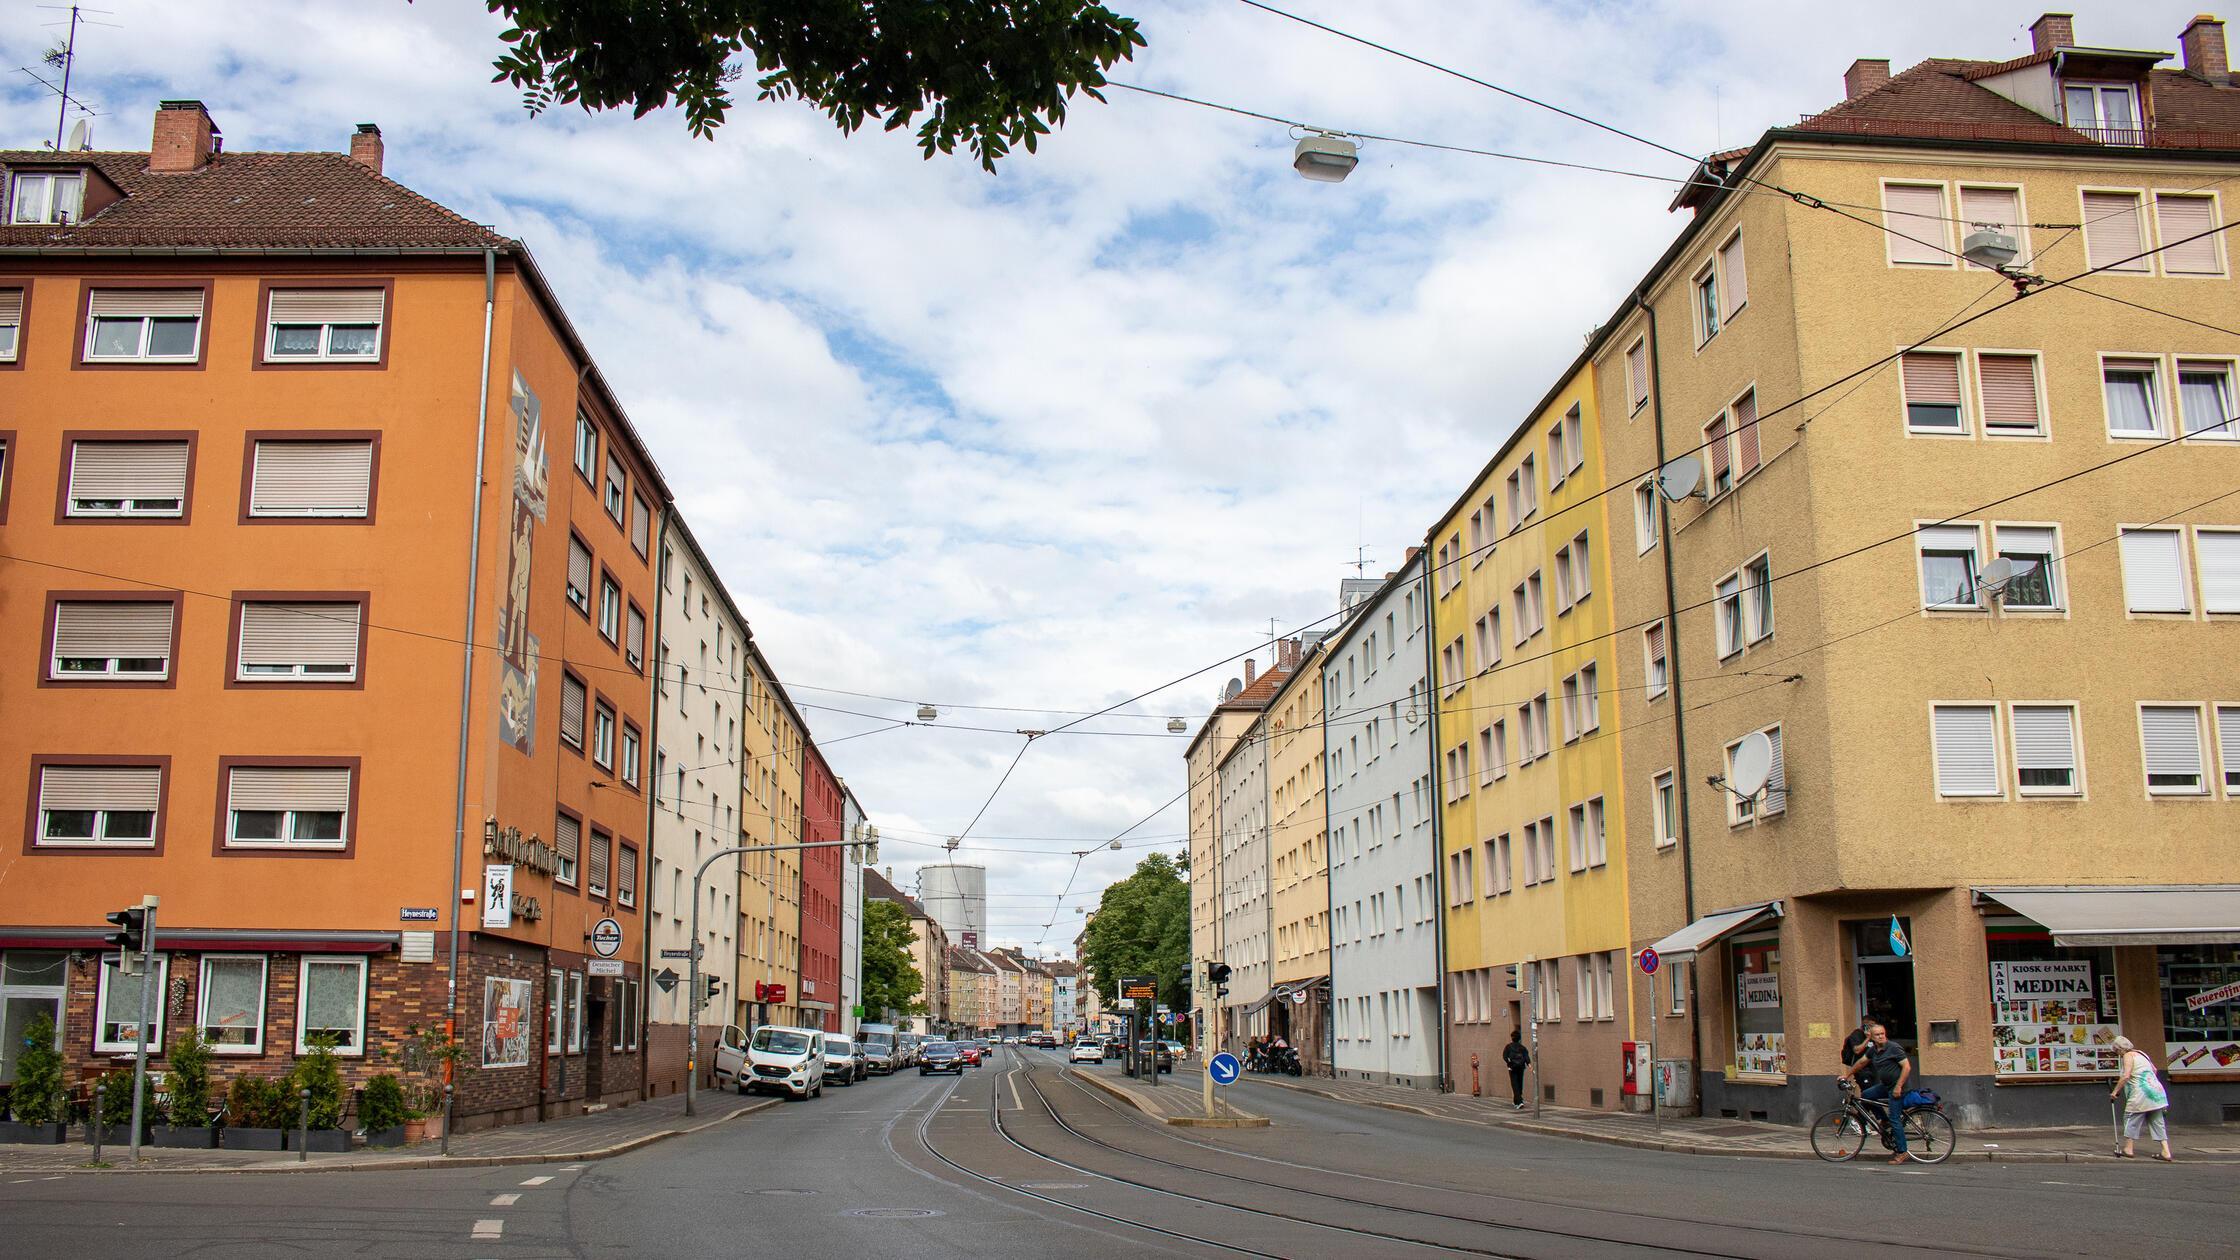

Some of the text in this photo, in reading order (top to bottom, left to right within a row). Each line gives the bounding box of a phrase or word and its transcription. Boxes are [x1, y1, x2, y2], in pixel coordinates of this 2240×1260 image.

[401, 909, 436, 919] Heynestraße
[2012, 965, 2087, 973] KIOSK & MARKT
[1995, 963, 2005, 1001] TABAK
[2014, 979, 2090, 993] MEDINA
[1748, 990, 1778, 1002] MEDINA
